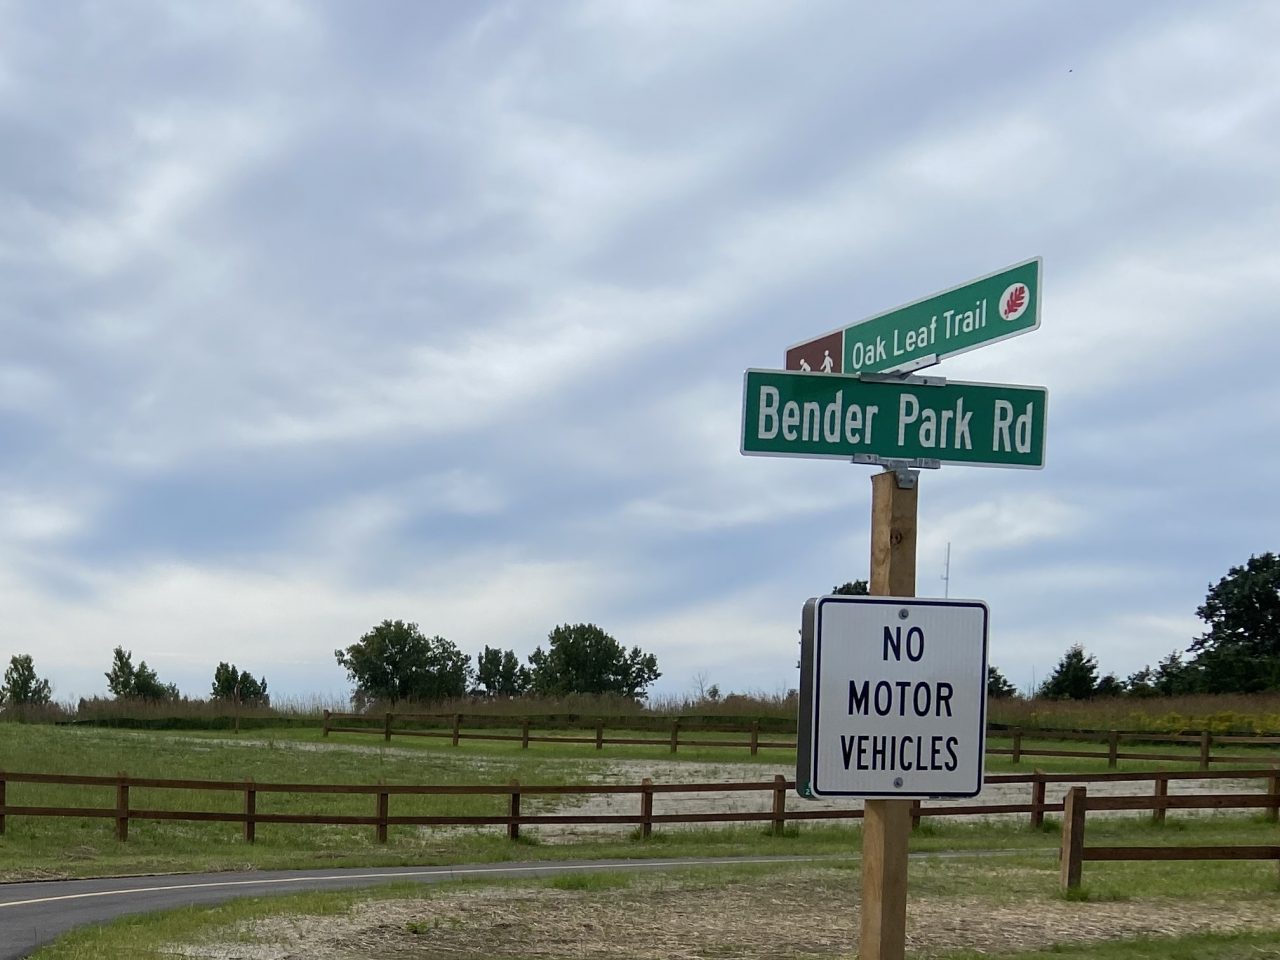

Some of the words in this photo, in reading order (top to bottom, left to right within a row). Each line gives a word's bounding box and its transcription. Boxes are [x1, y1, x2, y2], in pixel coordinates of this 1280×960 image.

[852, 336, 887, 369] Oak
[893, 316, 937, 357] Leaf
[943, 298, 987, 339] Trail
[758, 386, 878, 444] Bender
[898, 394, 973, 450] Park
[993, 400, 1033, 453] Rd
[883, 626, 924, 661] NO
[848, 680, 953, 717] MOTOR
[841, 735, 958, 771] VEHICLES
